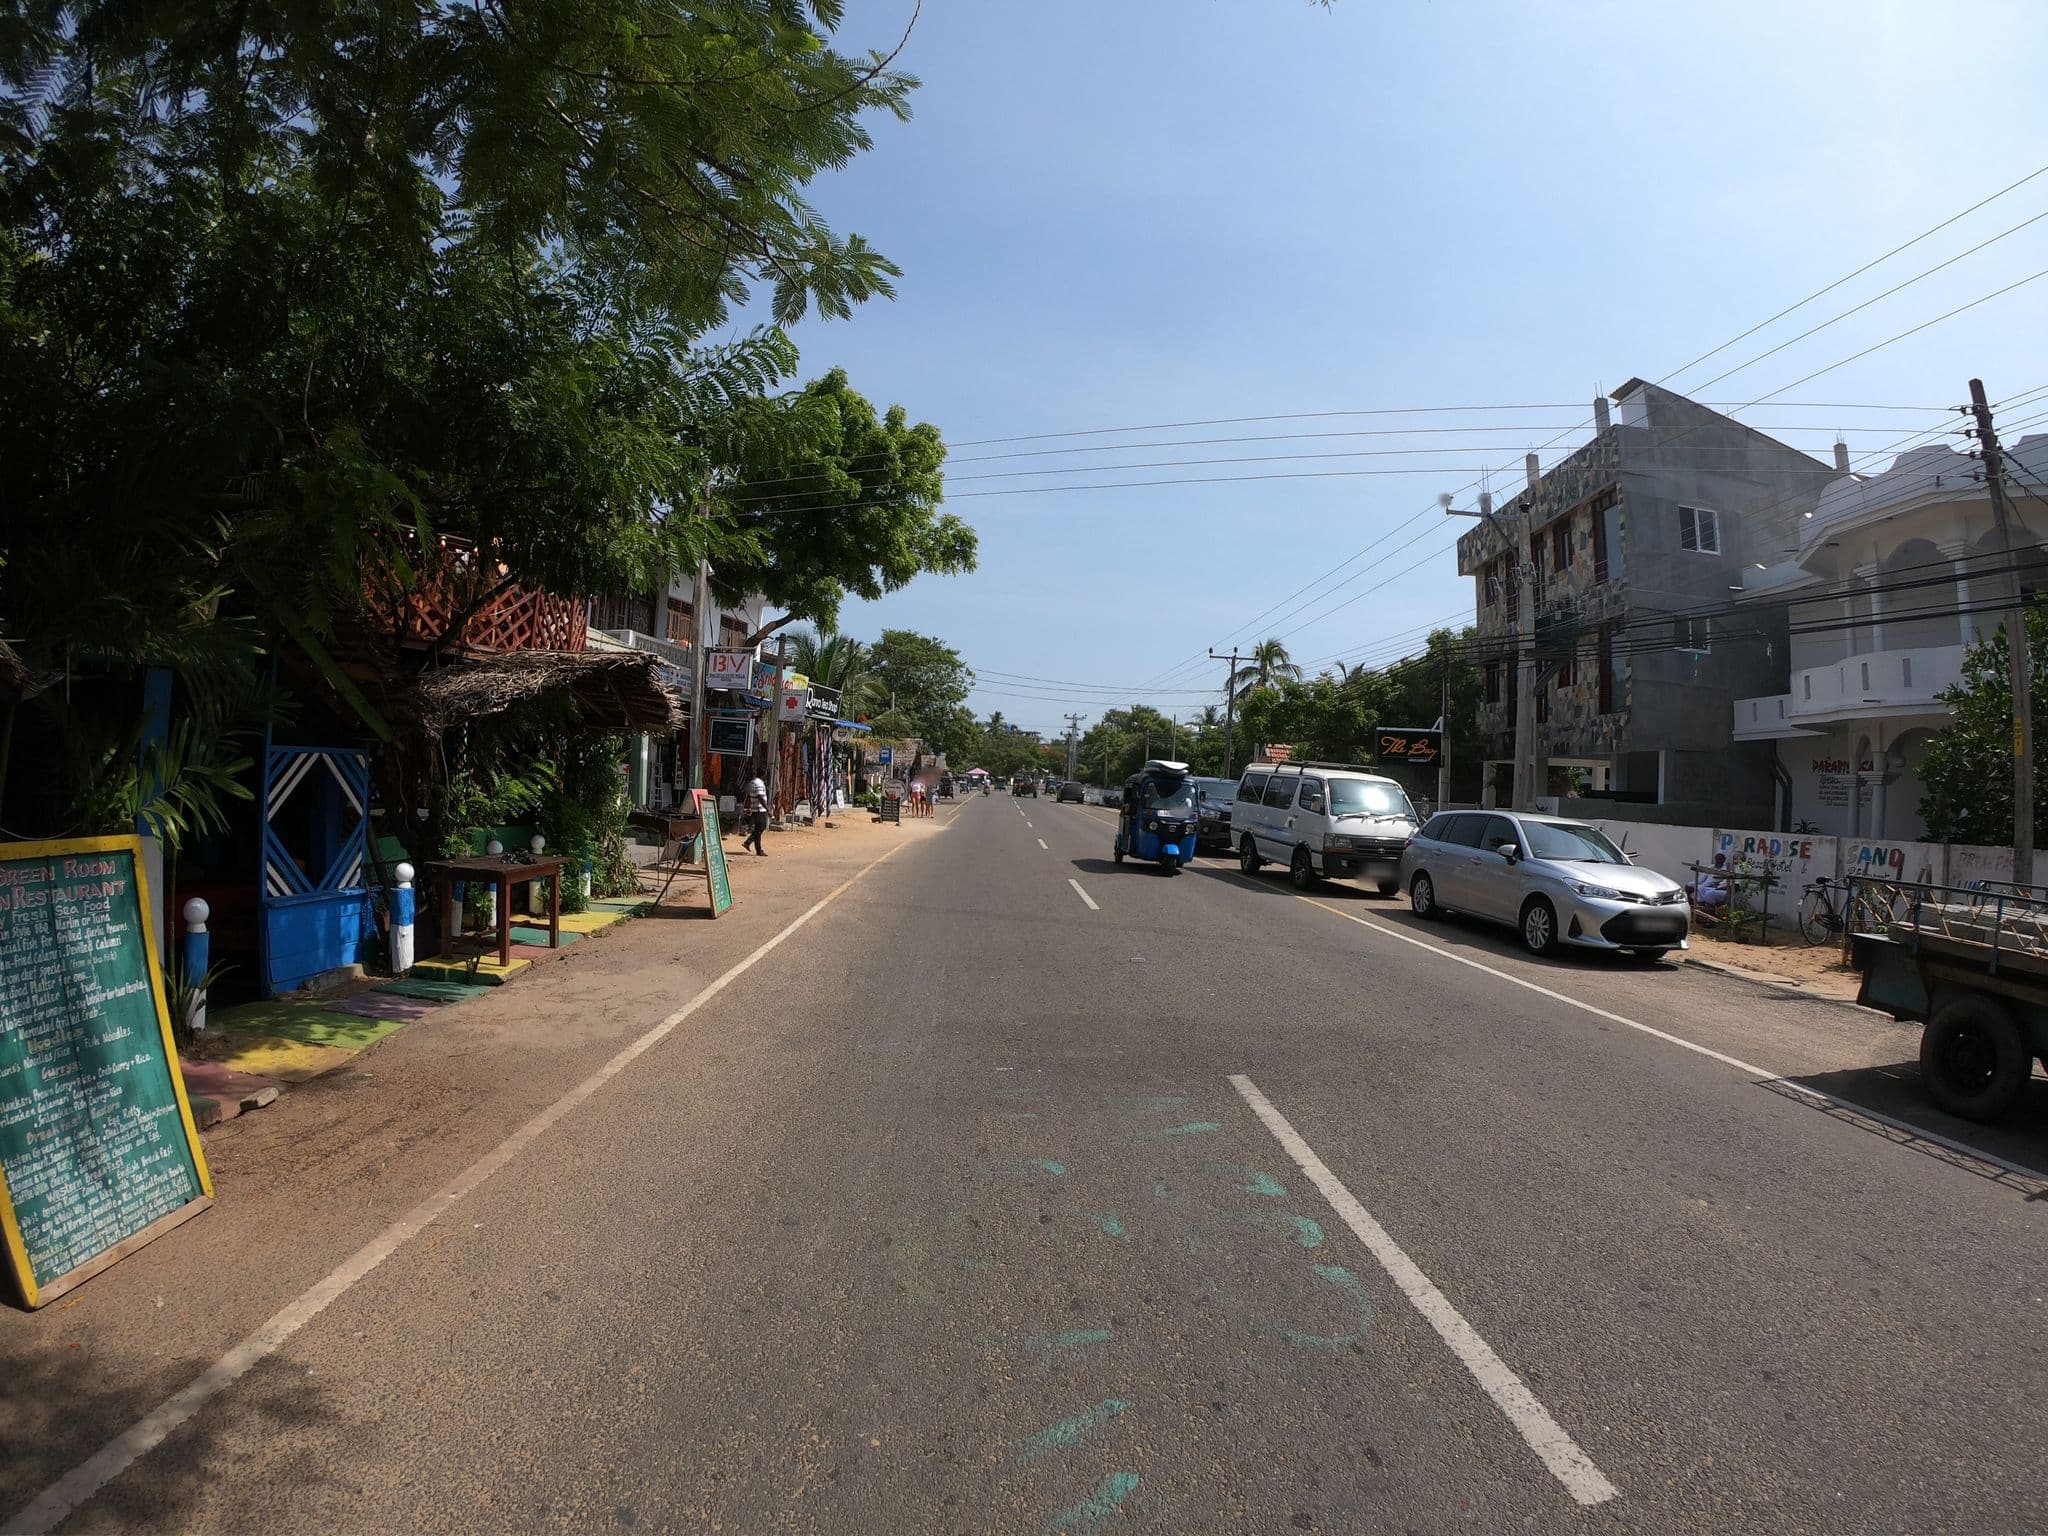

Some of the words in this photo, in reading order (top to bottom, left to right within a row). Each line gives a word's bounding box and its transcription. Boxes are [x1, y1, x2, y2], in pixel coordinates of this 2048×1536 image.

[1381, 736, 1407, 756] The
[1812, 760, 1850, 774] PARADI
[11, 879, 126, 910] RESTAURANT
[12, 908, 48, 924] Fresh
[55, 904, 79, 917] Sea
[84, 897, 111, 915] Food
